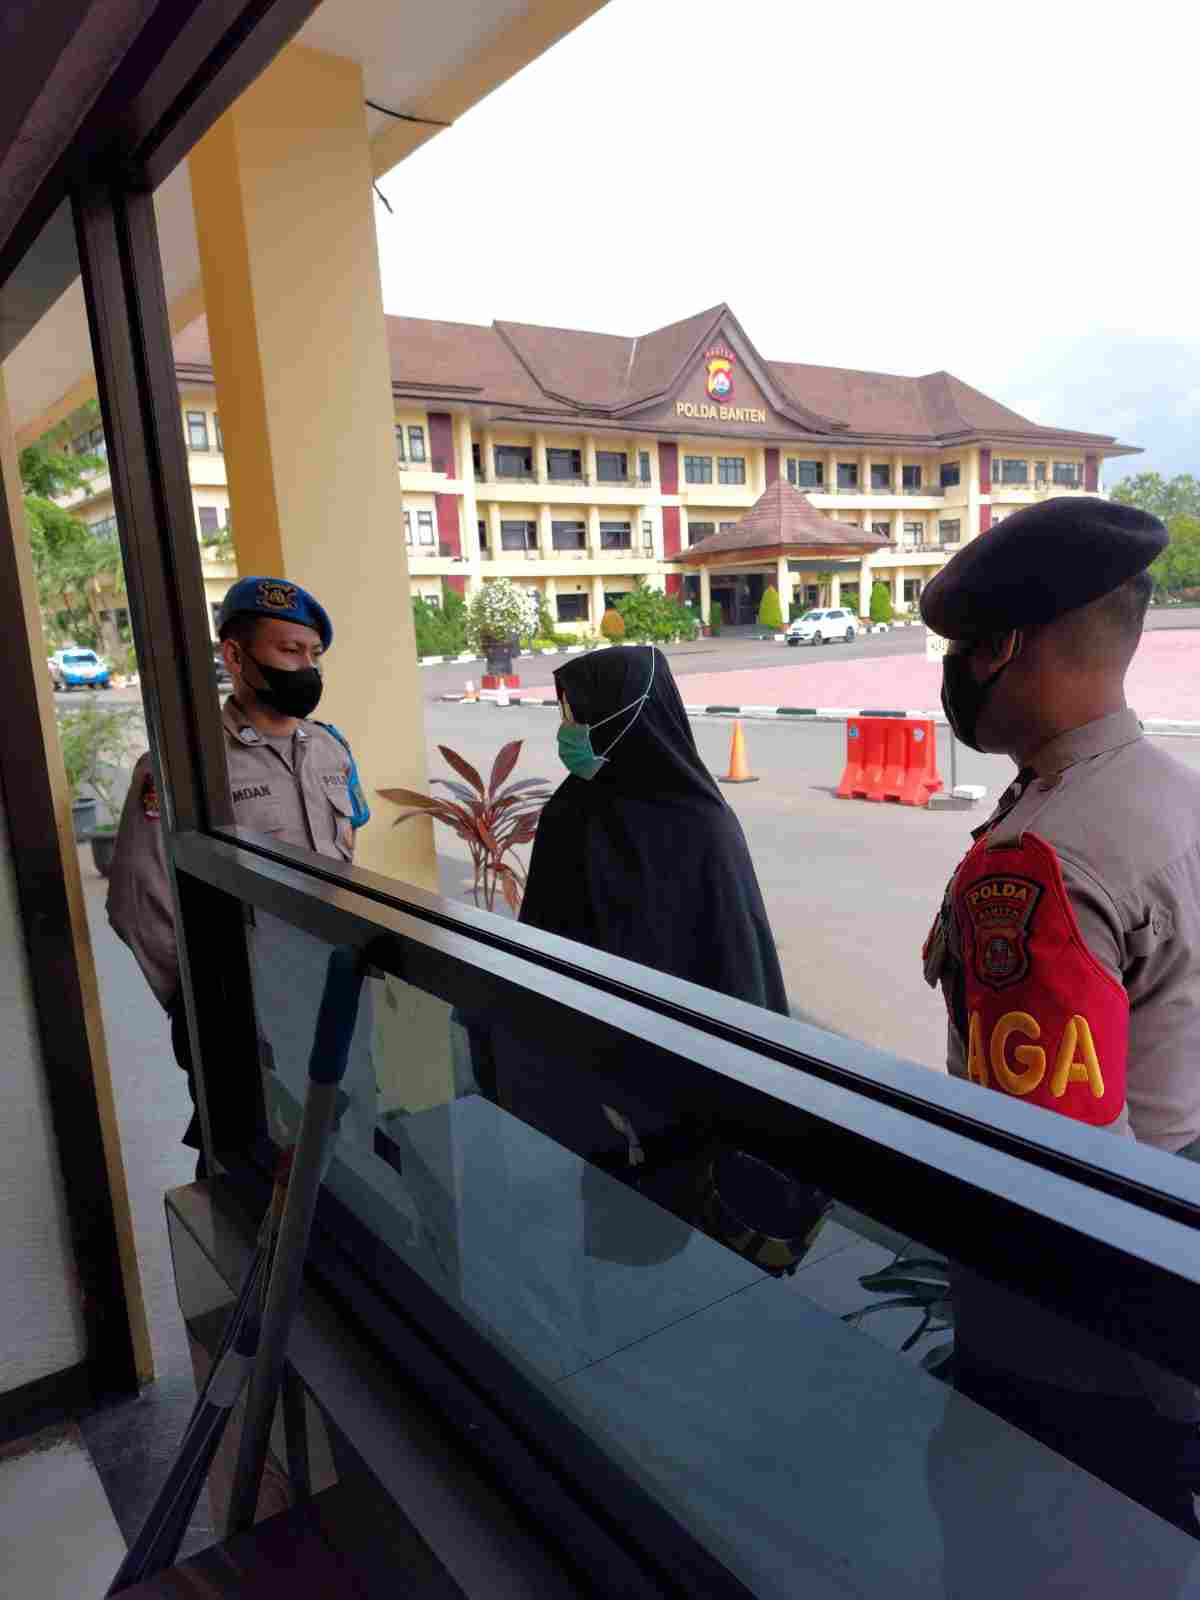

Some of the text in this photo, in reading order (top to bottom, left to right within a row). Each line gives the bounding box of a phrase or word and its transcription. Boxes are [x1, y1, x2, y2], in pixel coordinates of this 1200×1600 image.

[676, 402, 766, 423] POLDA BANTEN
[969, 882, 1026, 902] POLDA
